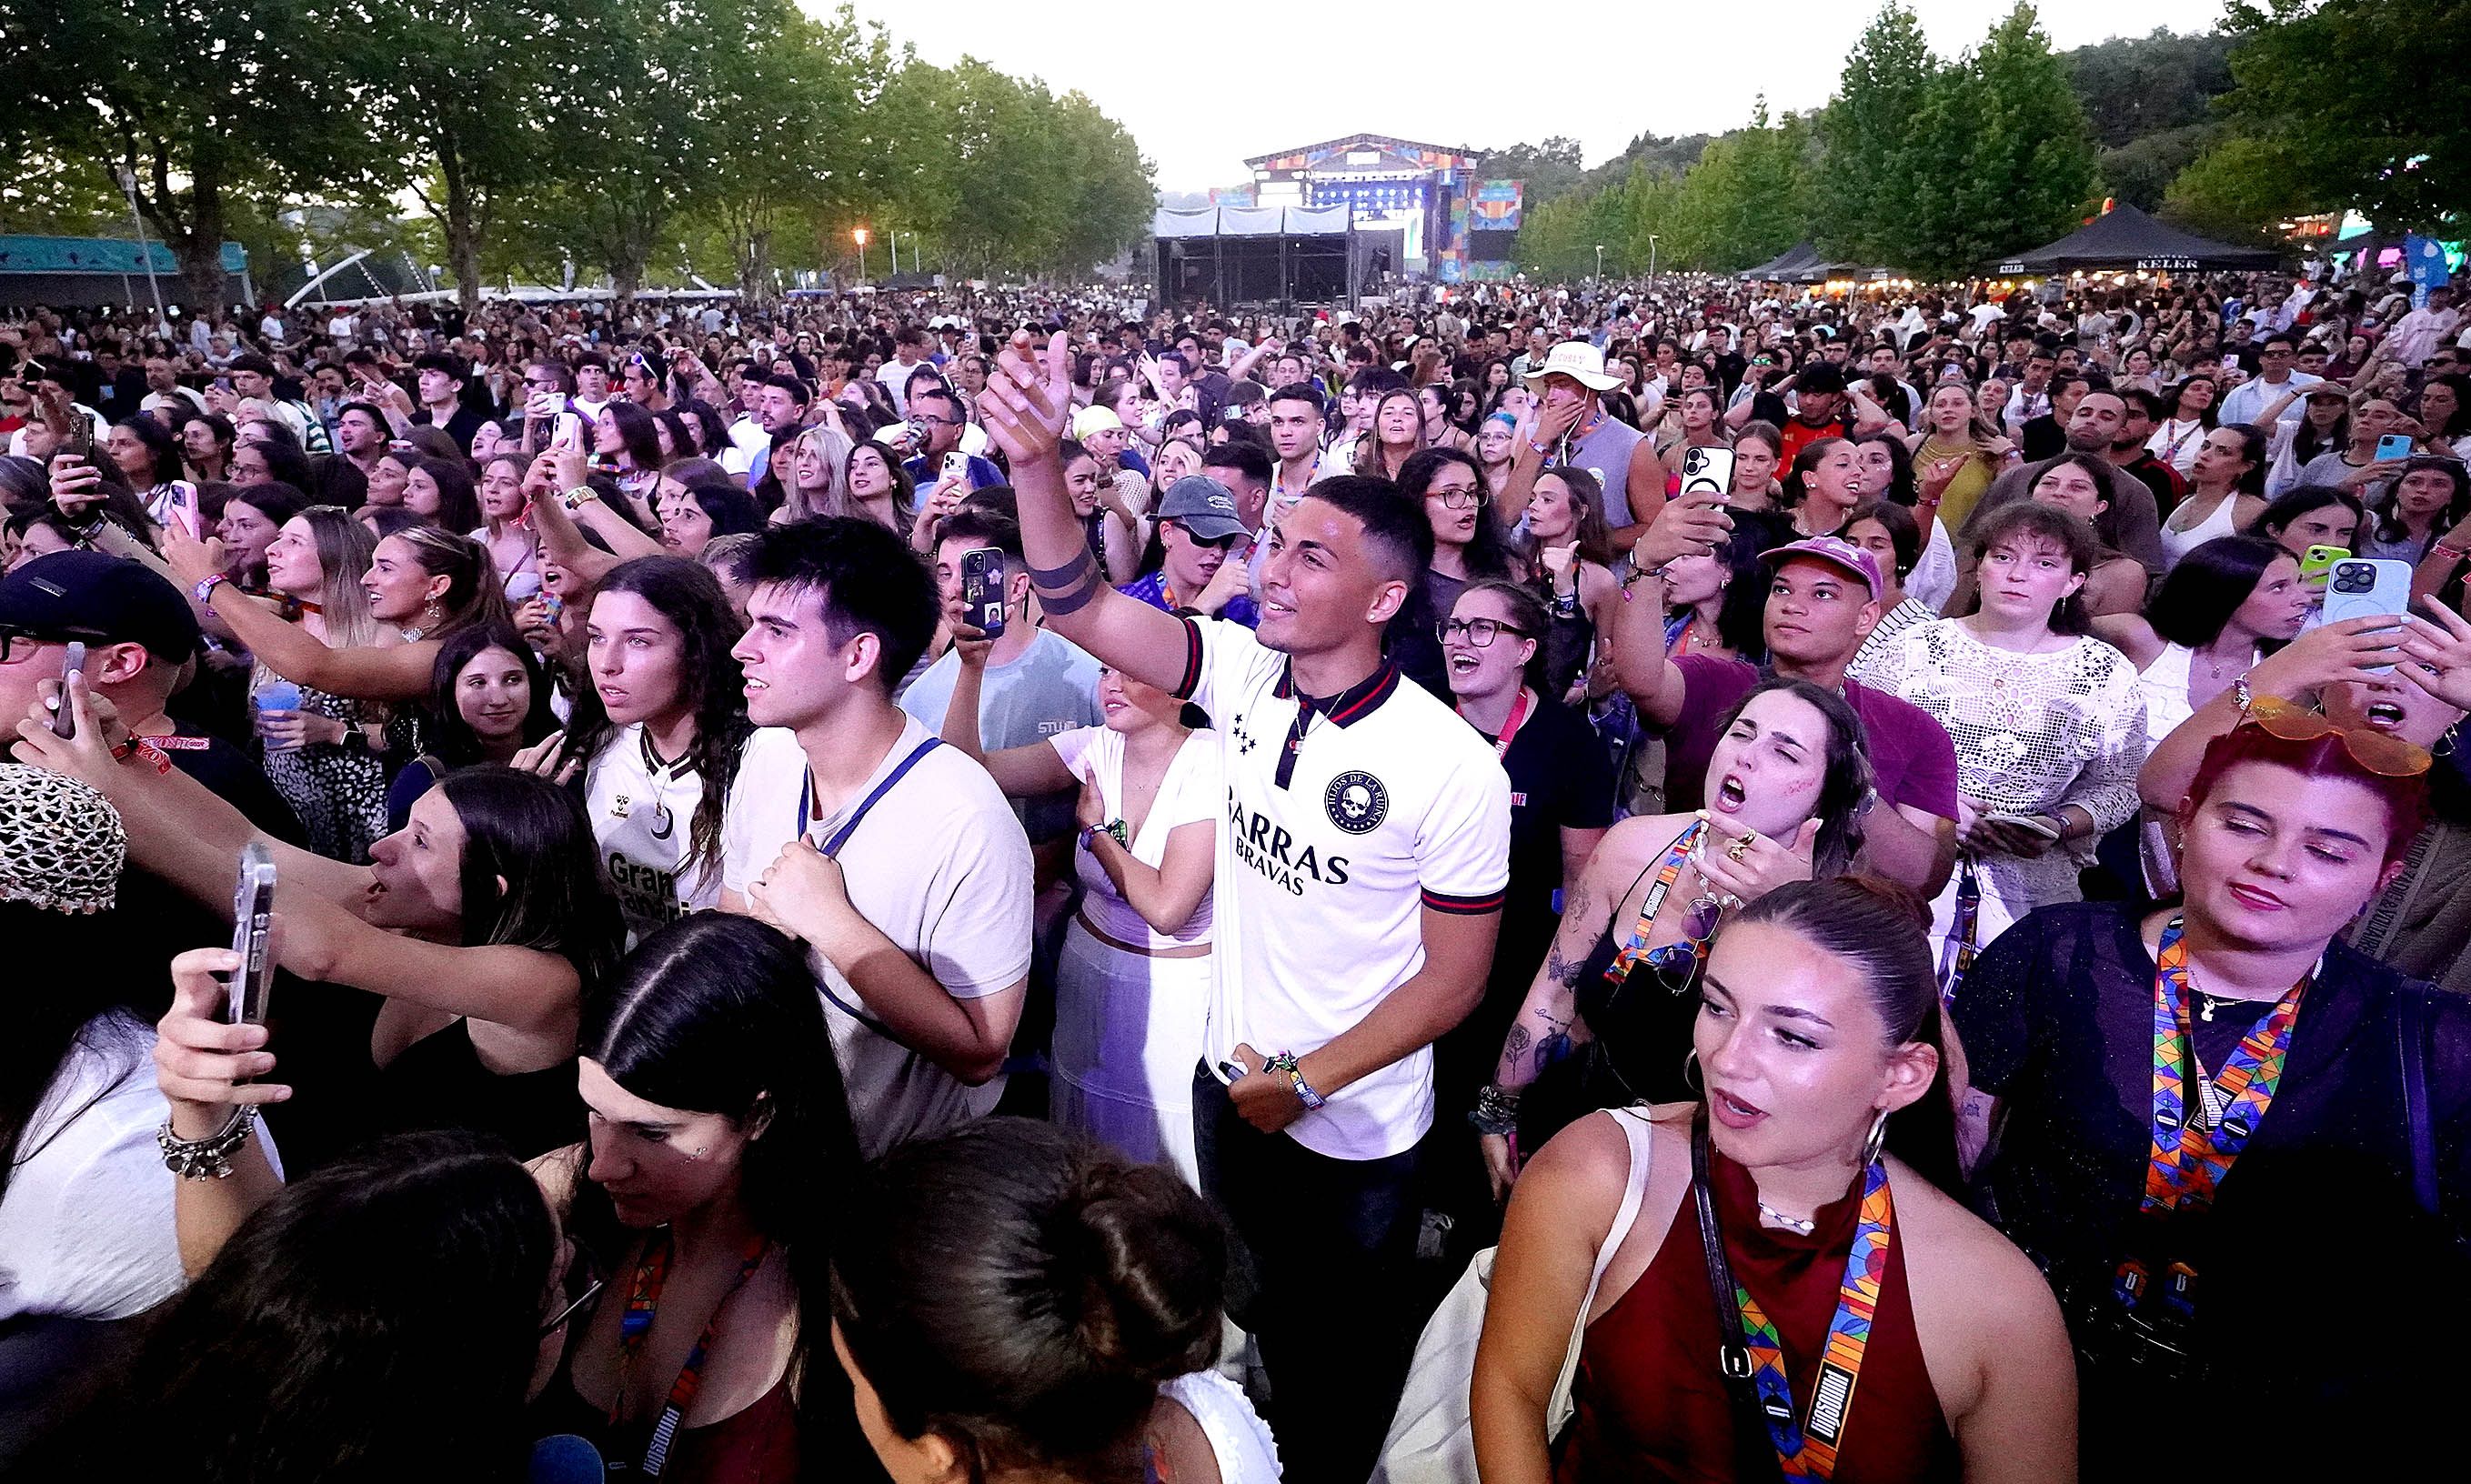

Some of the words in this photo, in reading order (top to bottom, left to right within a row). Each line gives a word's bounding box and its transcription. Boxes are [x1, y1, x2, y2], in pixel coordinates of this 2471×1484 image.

[2137, 259, 2198, 269] KELER
[1329, 777, 1347, 805] HIJOS
[1365, 777, 1377, 791] LA
[1370, 791, 1385, 822] RUINA
[608, 852, 674, 898] Gran
[1236, 836, 1304, 897] BRAVAS
[2357, 908, 2398, 955] VOLTAIRE
